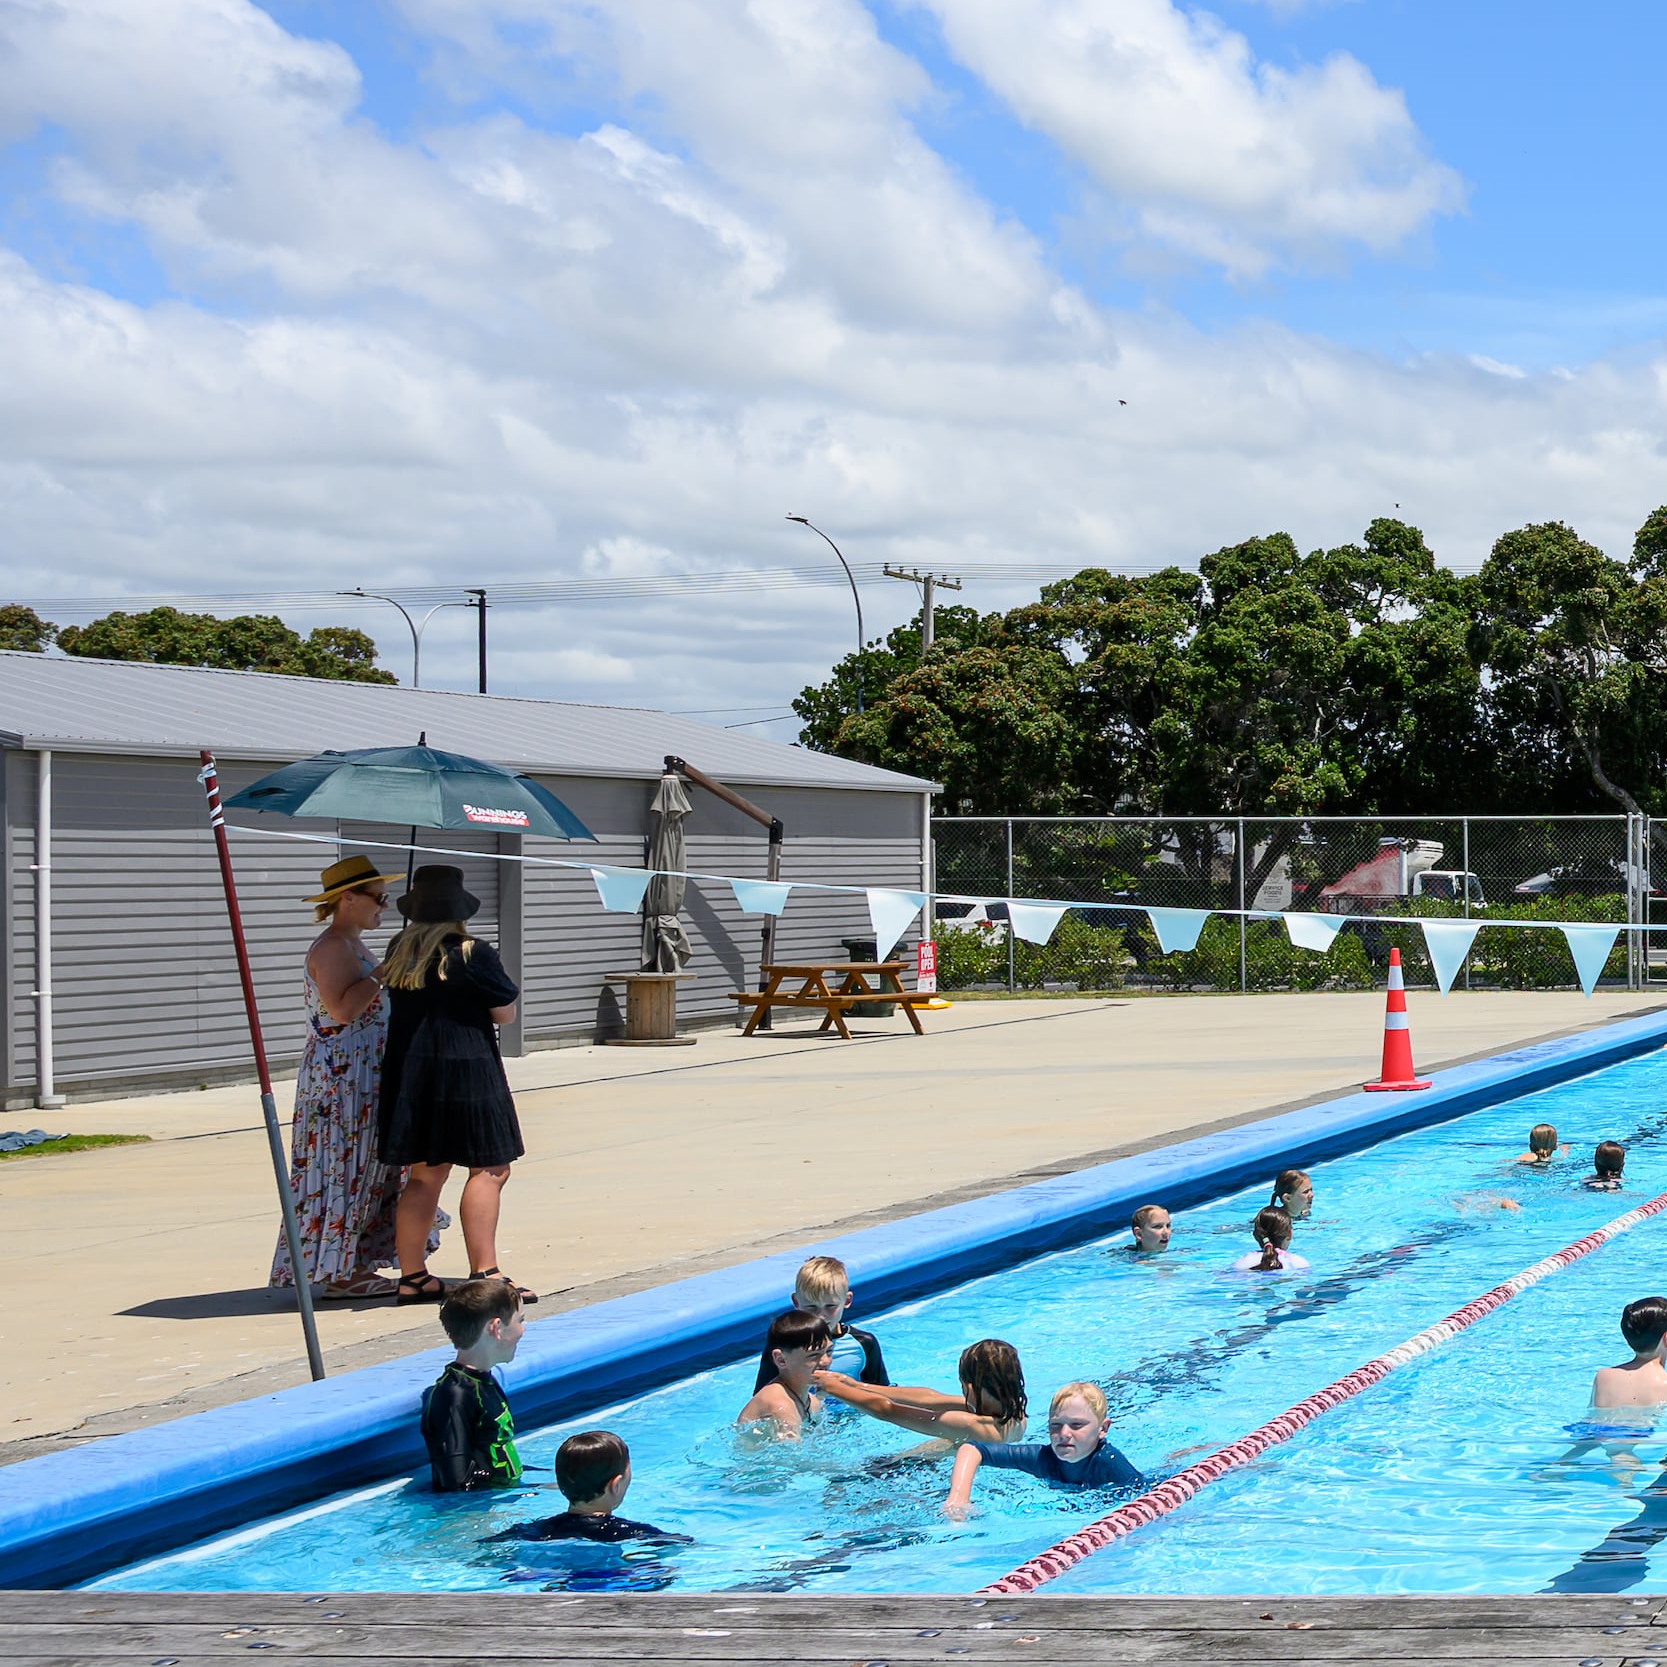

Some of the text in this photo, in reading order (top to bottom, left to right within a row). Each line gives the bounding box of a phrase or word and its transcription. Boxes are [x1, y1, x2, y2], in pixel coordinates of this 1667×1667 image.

[462, 804, 528, 820] BUNNINGS
[921, 946, 933, 958] POOL
[921, 958, 934, 971] OPEN
